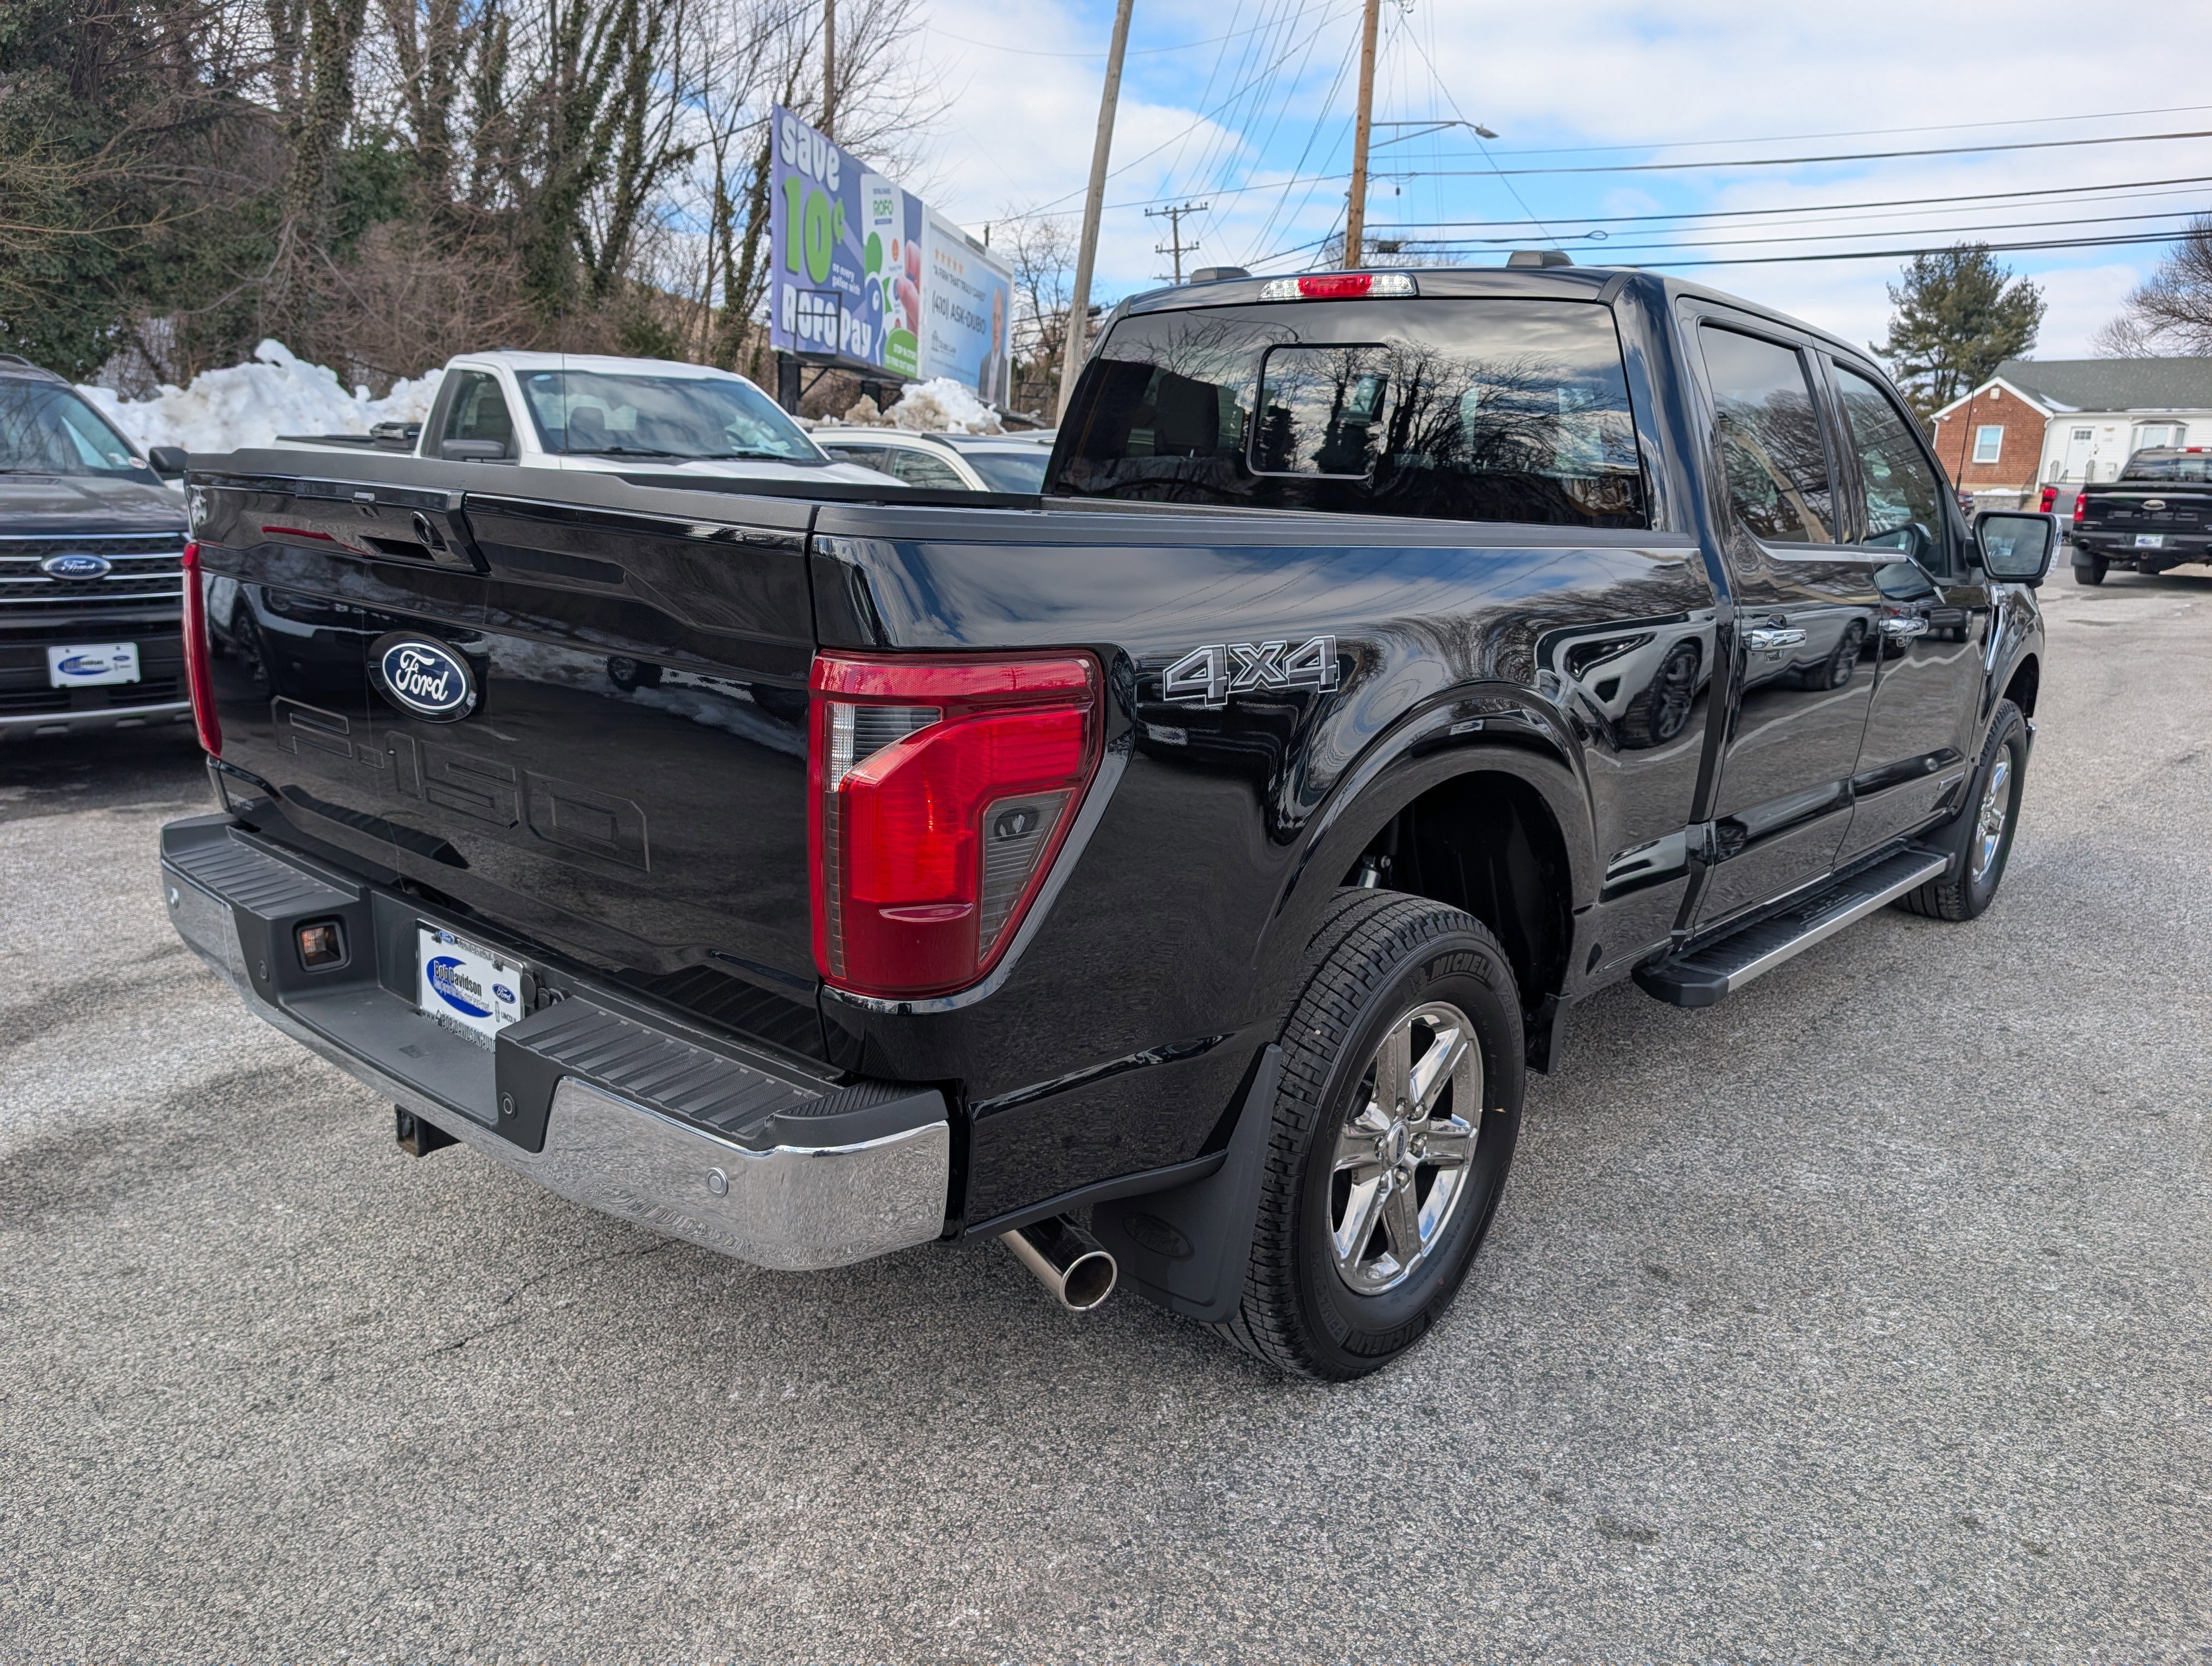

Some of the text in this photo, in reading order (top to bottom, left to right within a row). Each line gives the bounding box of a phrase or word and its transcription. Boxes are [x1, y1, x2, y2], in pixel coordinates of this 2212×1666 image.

[395, 650, 449, 701] Ford
[271, 694, 651, 873] F-150
[434, 960, 448, 981] Bob
[449, 966, 482, 997] Davidson
[497, 986, 511, 1002] Ford
